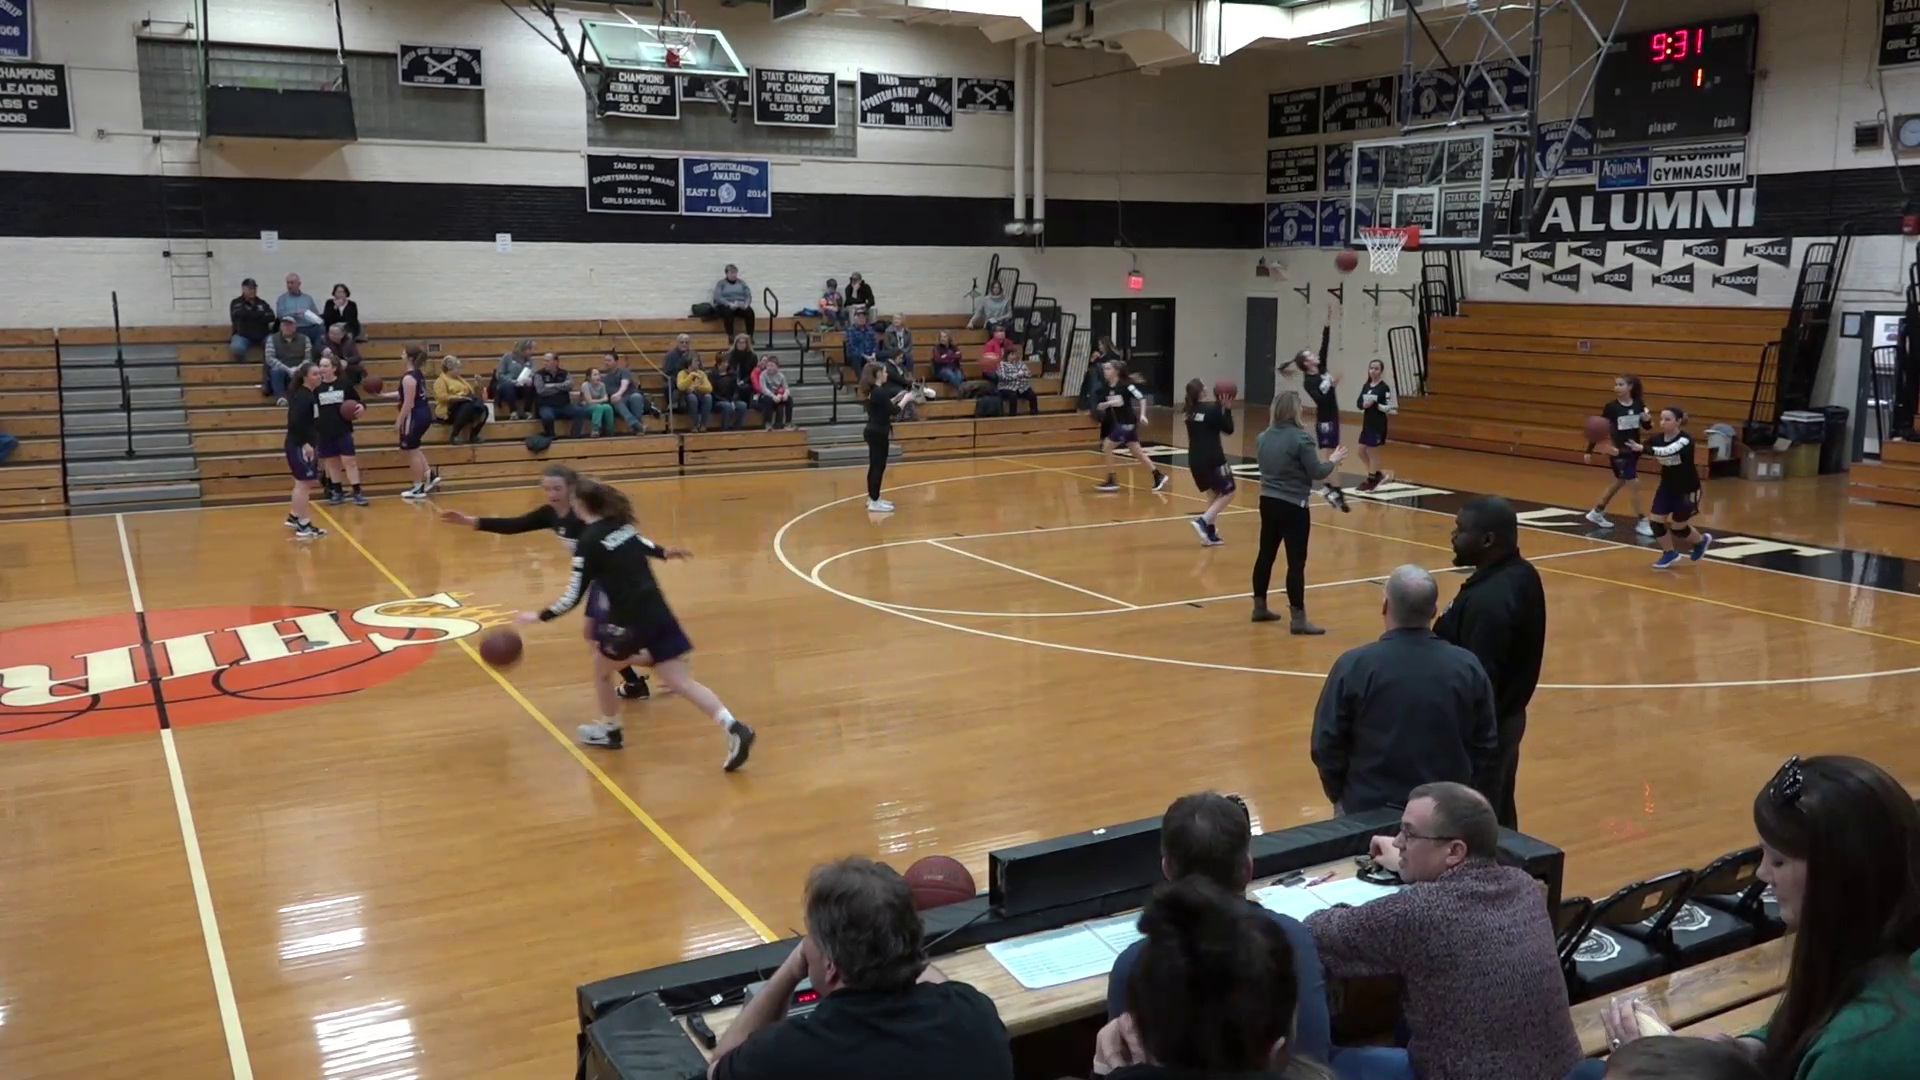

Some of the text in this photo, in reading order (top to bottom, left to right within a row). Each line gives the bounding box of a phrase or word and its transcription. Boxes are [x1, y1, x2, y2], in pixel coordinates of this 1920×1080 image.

[1651, 29, 1704, 60] 9:31
[1886, 37, 1918, 50] GIRLS
[619, 72, 665, 85] CHAMPIONS
[762, 71, 830, 85] STATE CHAMPIONS
[1696, 68, 1703, 86] 1
[638, 84, 670, 96] CHAMPIONS
[767, 82, 825, 95] PVC CHAMPIONS
[1651, 77, 1682, 92] period
[606, 93, 630, 103] CLASS
[641, 96, 663, 105] GOLF
[761, 92, 831, 105] PVC REGIONAL CHAMPIONS
[861, 86, 919, 111] SPORTSMANSHIP
[928, 92, 952, 114] AWARD
[28, 100, 38, 110] C
[769, 103, 823, 114] CLASS C GOLF
[1283, 103, 1304, 114] GOLF
[867, 112, 946, 127] BOYS BASKETBALL
[1713, 116, 1736, 129] fouls
[1648, 122, 1677, 136] player
[613, 162, 637, 171] IAABO
[710, 162, 759, 176] SPORTSMANSHIP
[1602, 157, 1642, 178] AQUAFINA
[712, 172, 741, 181] AWARD
[1653, 163, 1742, 182] GYMNASIUM
[592, 173, 676, 187] SPORTSMANSHIP AWARD
[1270, 175, 1314, 186] CHEERLEADING
[685, 188, 716, 198] EAST D
[746, 190, 767, 199] 2014
[1446, 192, 1469, 202] STATE
[602, 197, 666, 208] GIRLS BASKETBALL
[707, 205, 748, 214] FOOTBALL
[1540, 188, 1756, 233] ALUMNI
[1483, 249, 1511, 258] CROUSE
[1527, 250, 1552, 260] COSBY
[1581, 247, 1603, 257] FORD
[1635, 247, 1659, 257] SHAW
[1691, 246, 1719, 256] FORD
[1752, 245, 1787, 256] DRAKE
[1604, 273, 1627, 282] FORD
[1660, 273, 1692, 283] DRAKE
[1720, 273, 1758, 284] PEABODY
